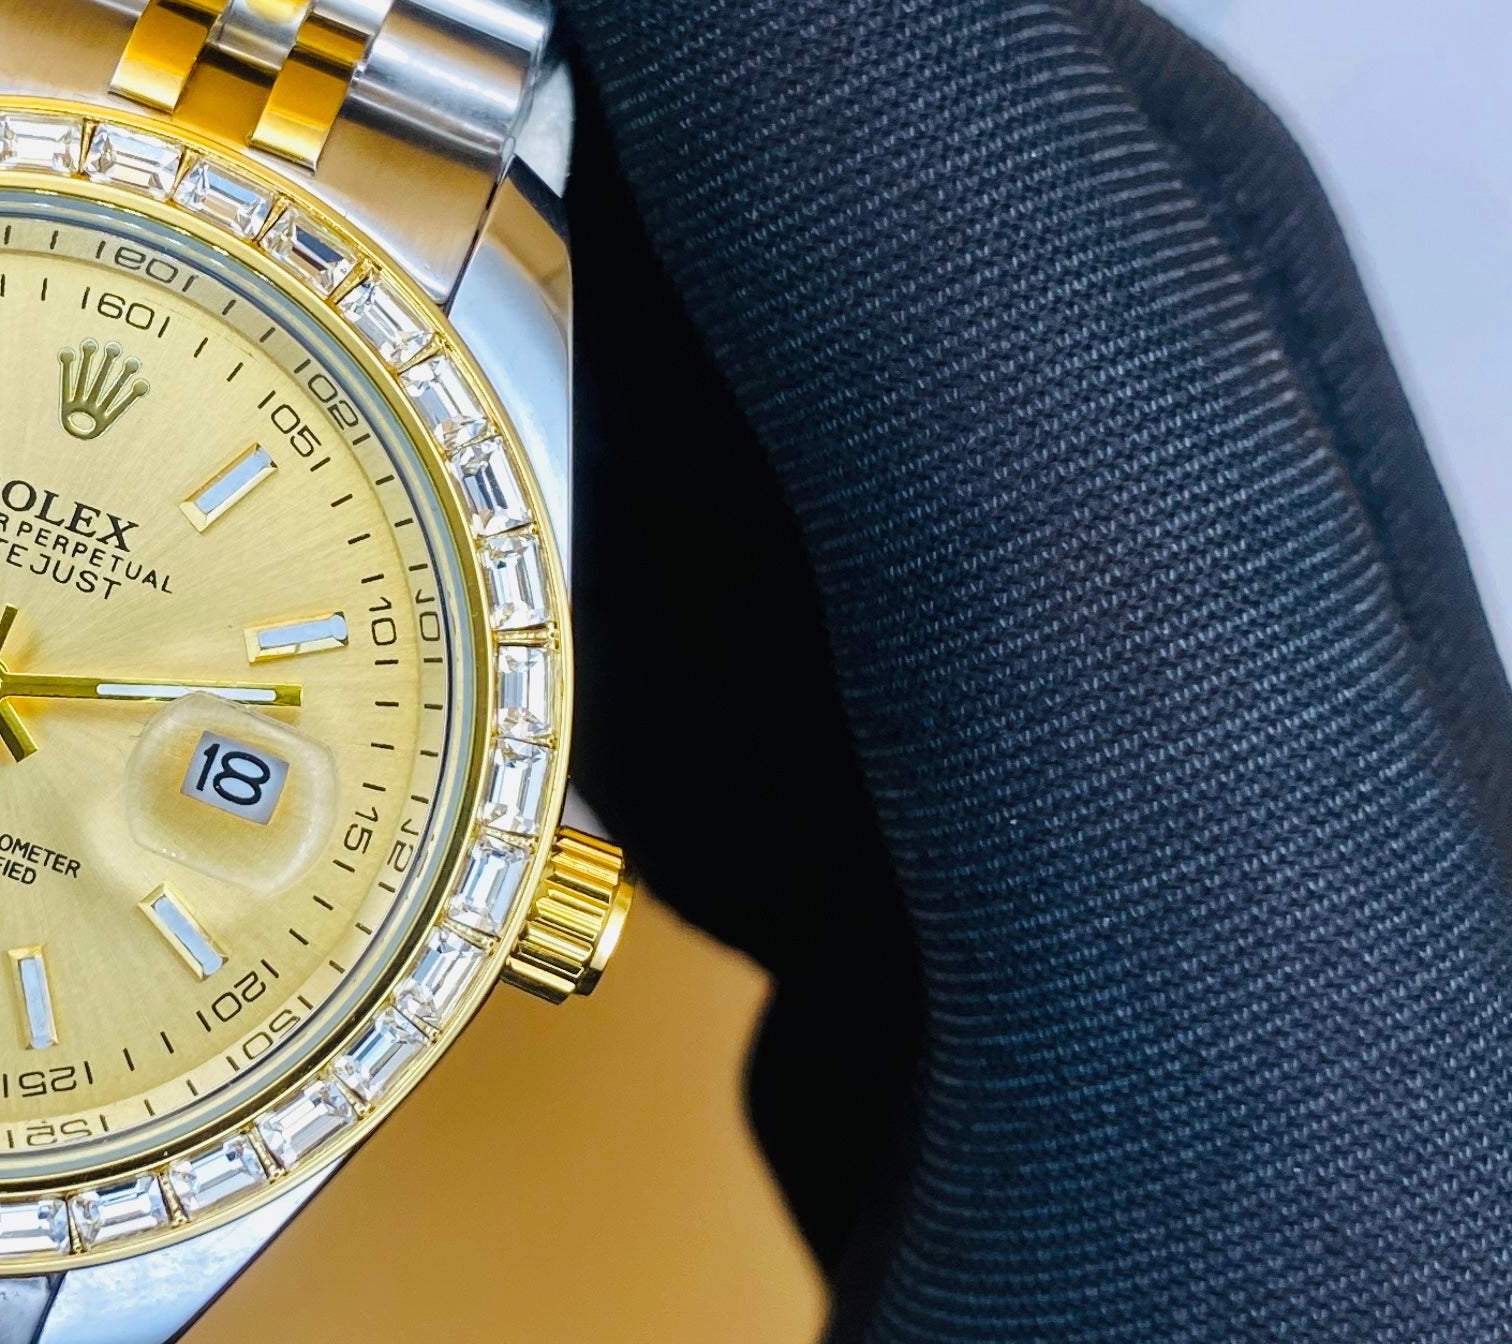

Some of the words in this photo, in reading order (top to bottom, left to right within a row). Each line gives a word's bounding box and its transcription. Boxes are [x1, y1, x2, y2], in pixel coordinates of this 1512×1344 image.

[97, 293, 155, 330] 60
[271, 404, 322, 458] 05
[16, 514, 174, 594] PERPETUAL
[369, 596, 397, 645] 10
[196, 743, 271, 806] 18
[344, 806, 379, 854] 15
[211, 970, 267, 1022] 20
[18, 1066, 76, 1097] 25
